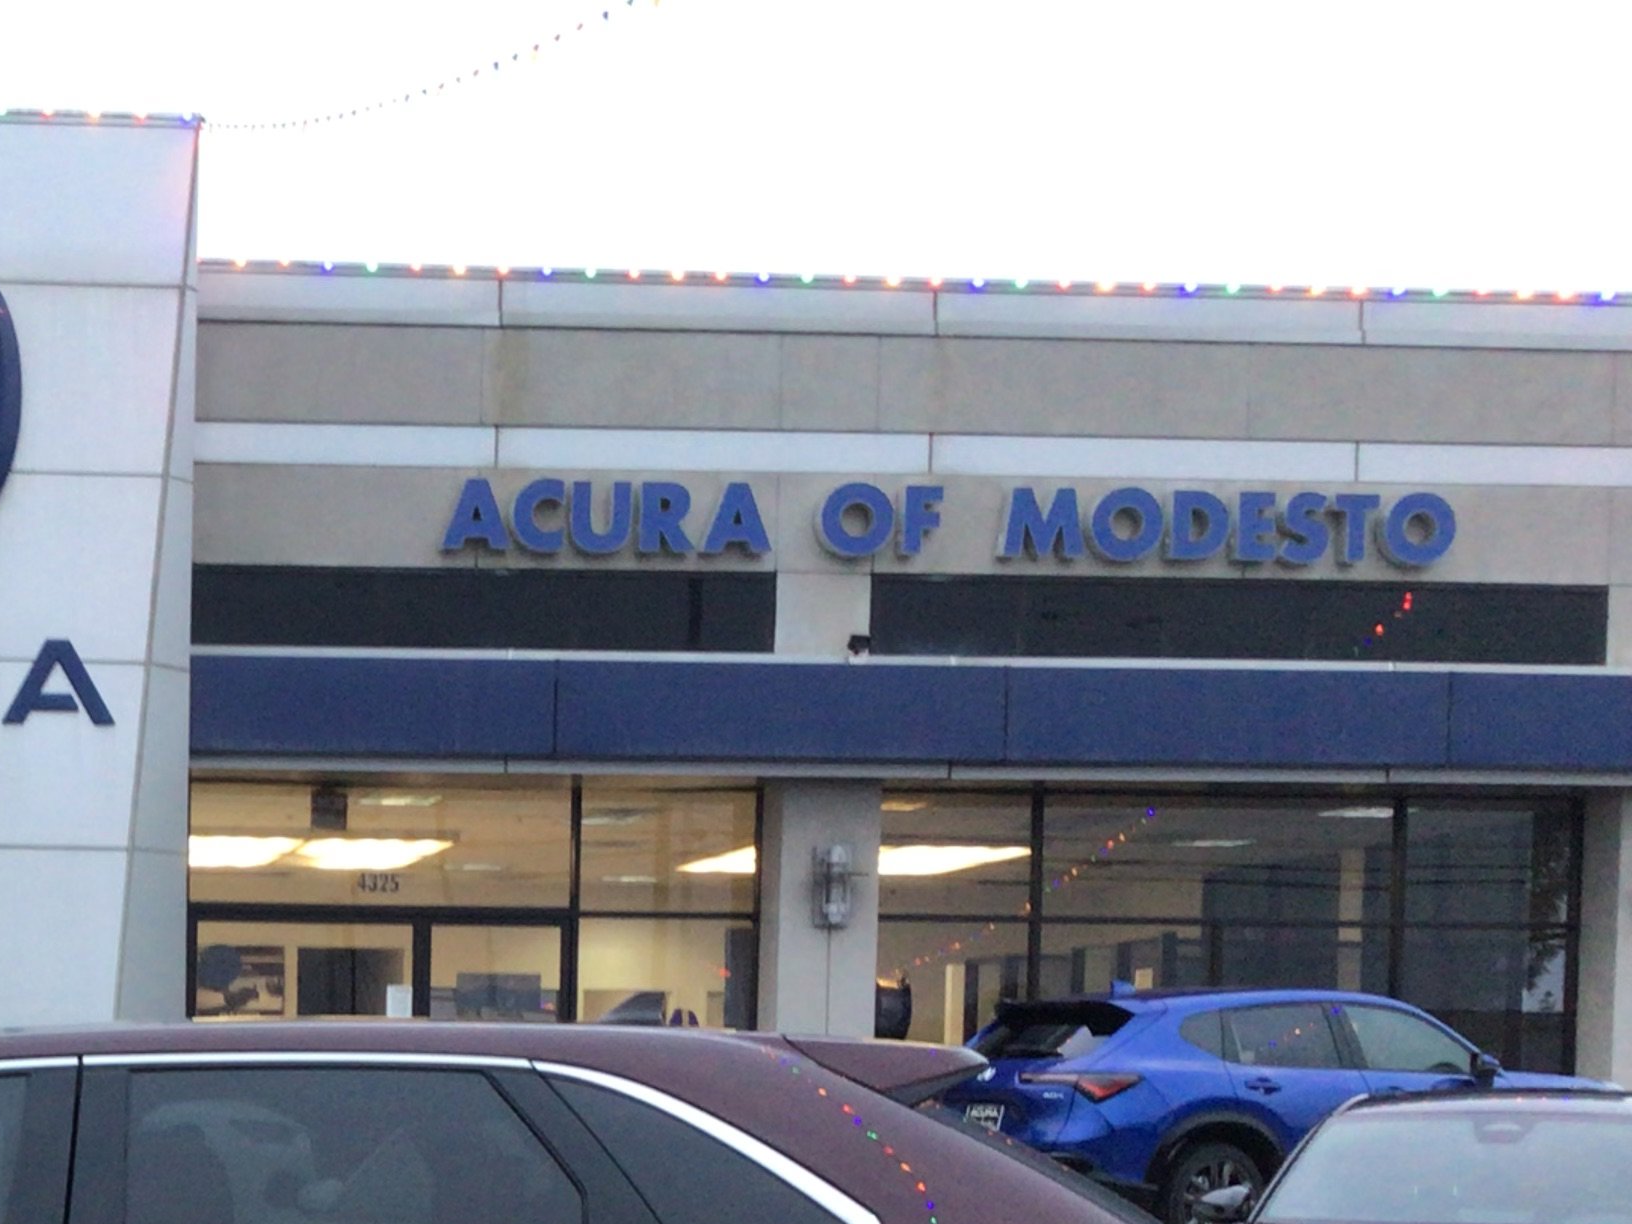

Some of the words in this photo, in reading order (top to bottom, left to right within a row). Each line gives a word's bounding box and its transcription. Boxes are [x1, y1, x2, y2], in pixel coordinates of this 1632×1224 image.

[440, 477, 773, 555] ACURA
[816, 482, 945, 558] OF
[998, 486, 1457, 567] MODESTO
[357, 872, 400, 893] 4325
